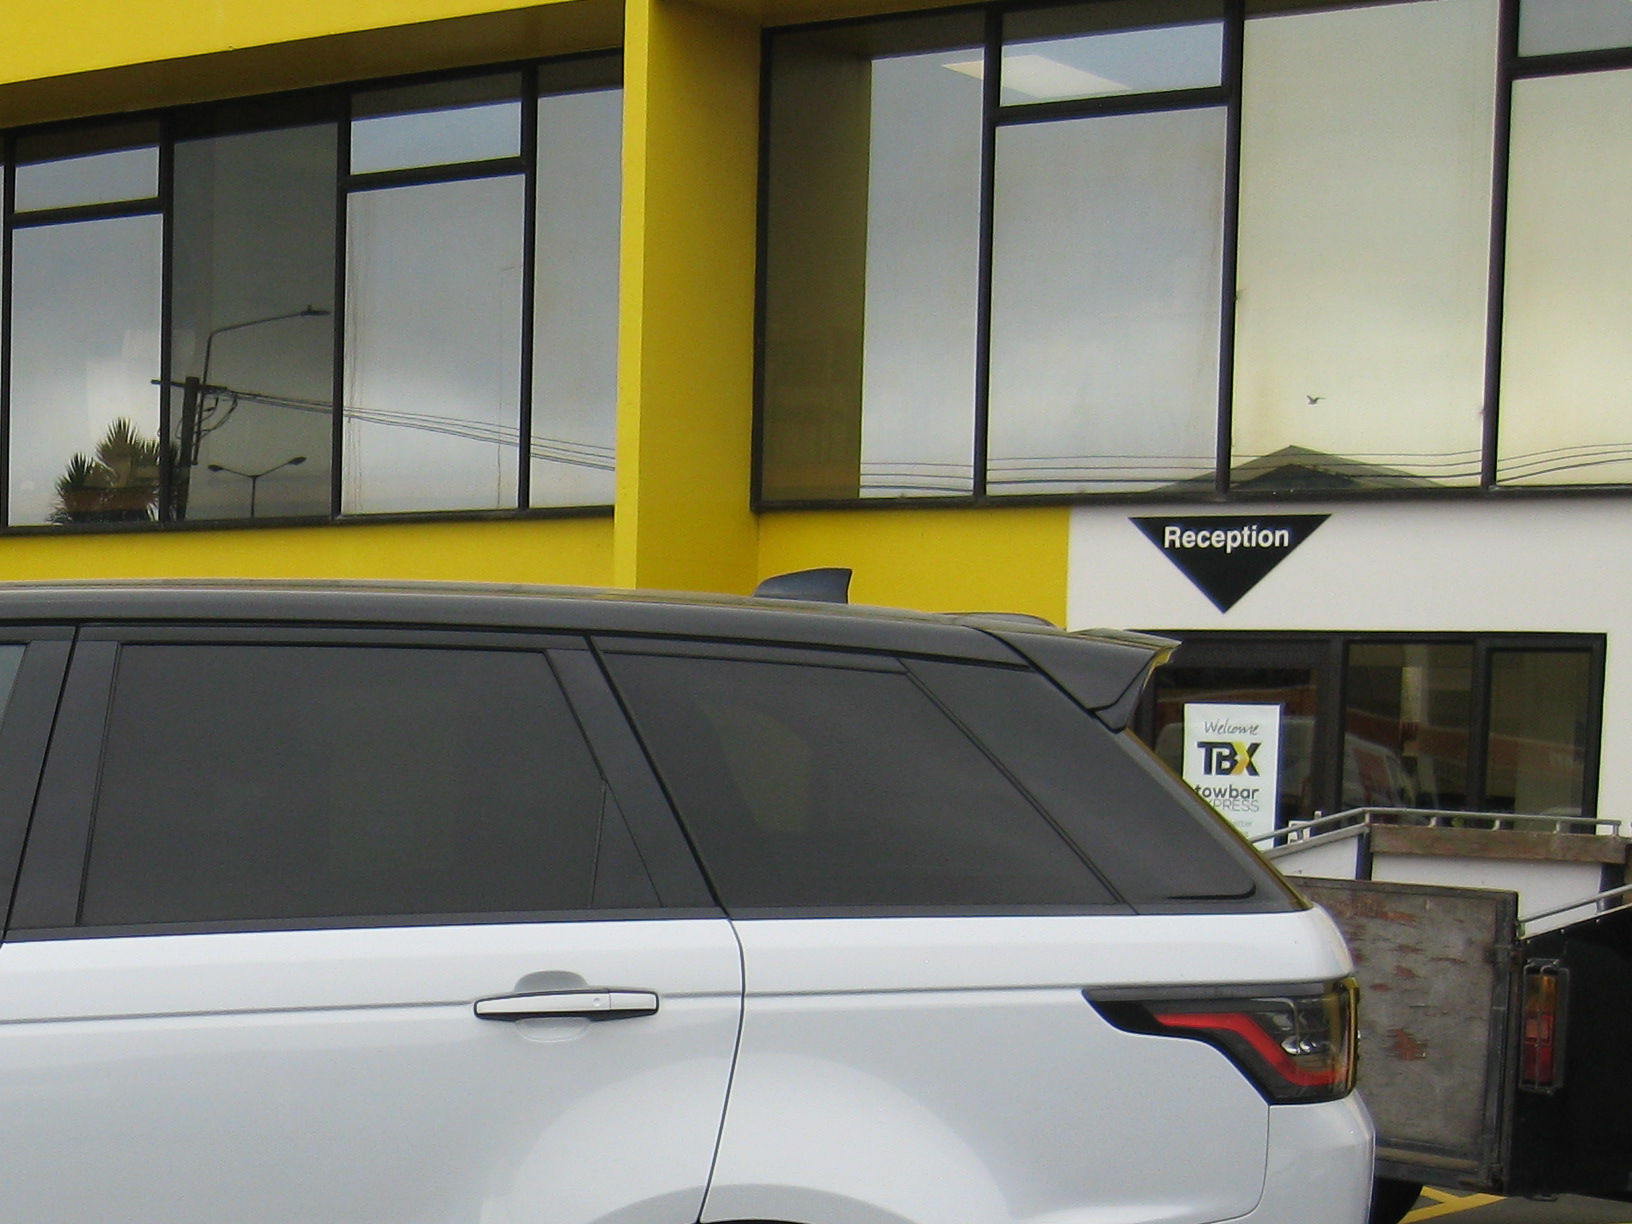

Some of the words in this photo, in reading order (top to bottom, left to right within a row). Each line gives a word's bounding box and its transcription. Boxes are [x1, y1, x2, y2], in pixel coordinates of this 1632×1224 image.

[1163, 525, 1290, 554] Reception
[1204, 717, 1260, 736] Welcome
[1196, 741, 1262, 777] TBX
[1209, 798, 1261, 812] PRESS
